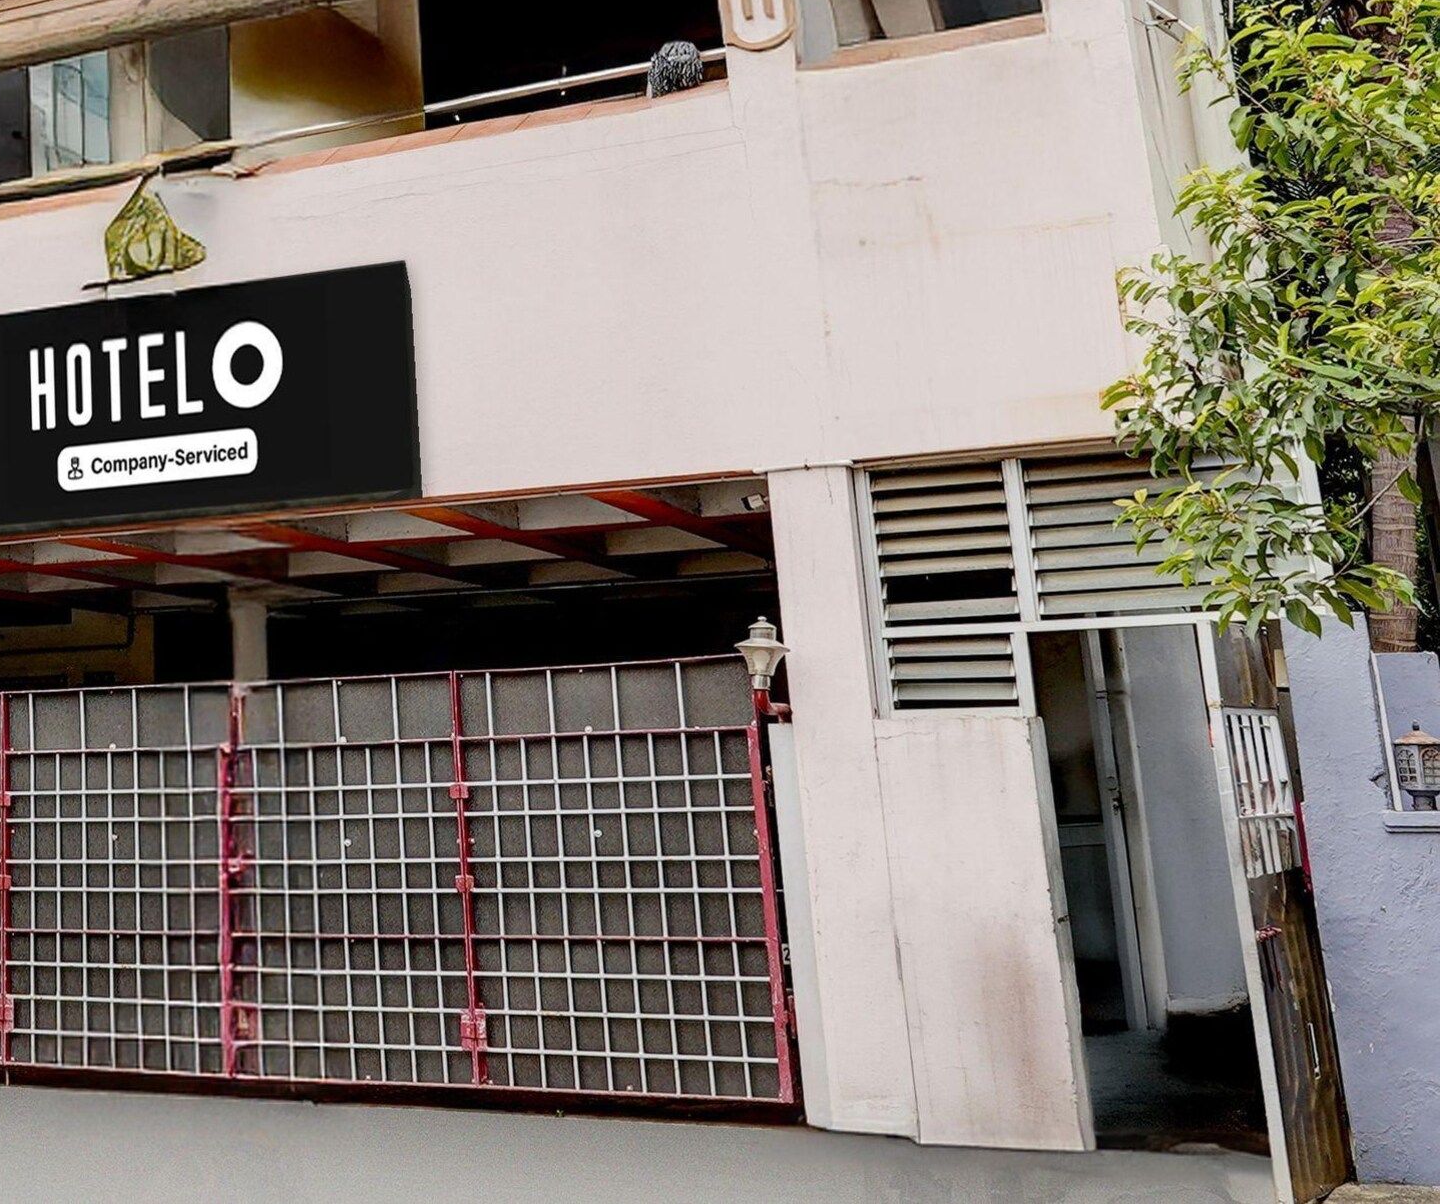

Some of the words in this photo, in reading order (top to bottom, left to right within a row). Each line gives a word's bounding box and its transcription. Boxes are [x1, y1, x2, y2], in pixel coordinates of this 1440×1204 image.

[29, 331, 204, 431] HOTEL
[212, 321, 284, 409] O
[90, 441, 249, 477] Company-Serviced
